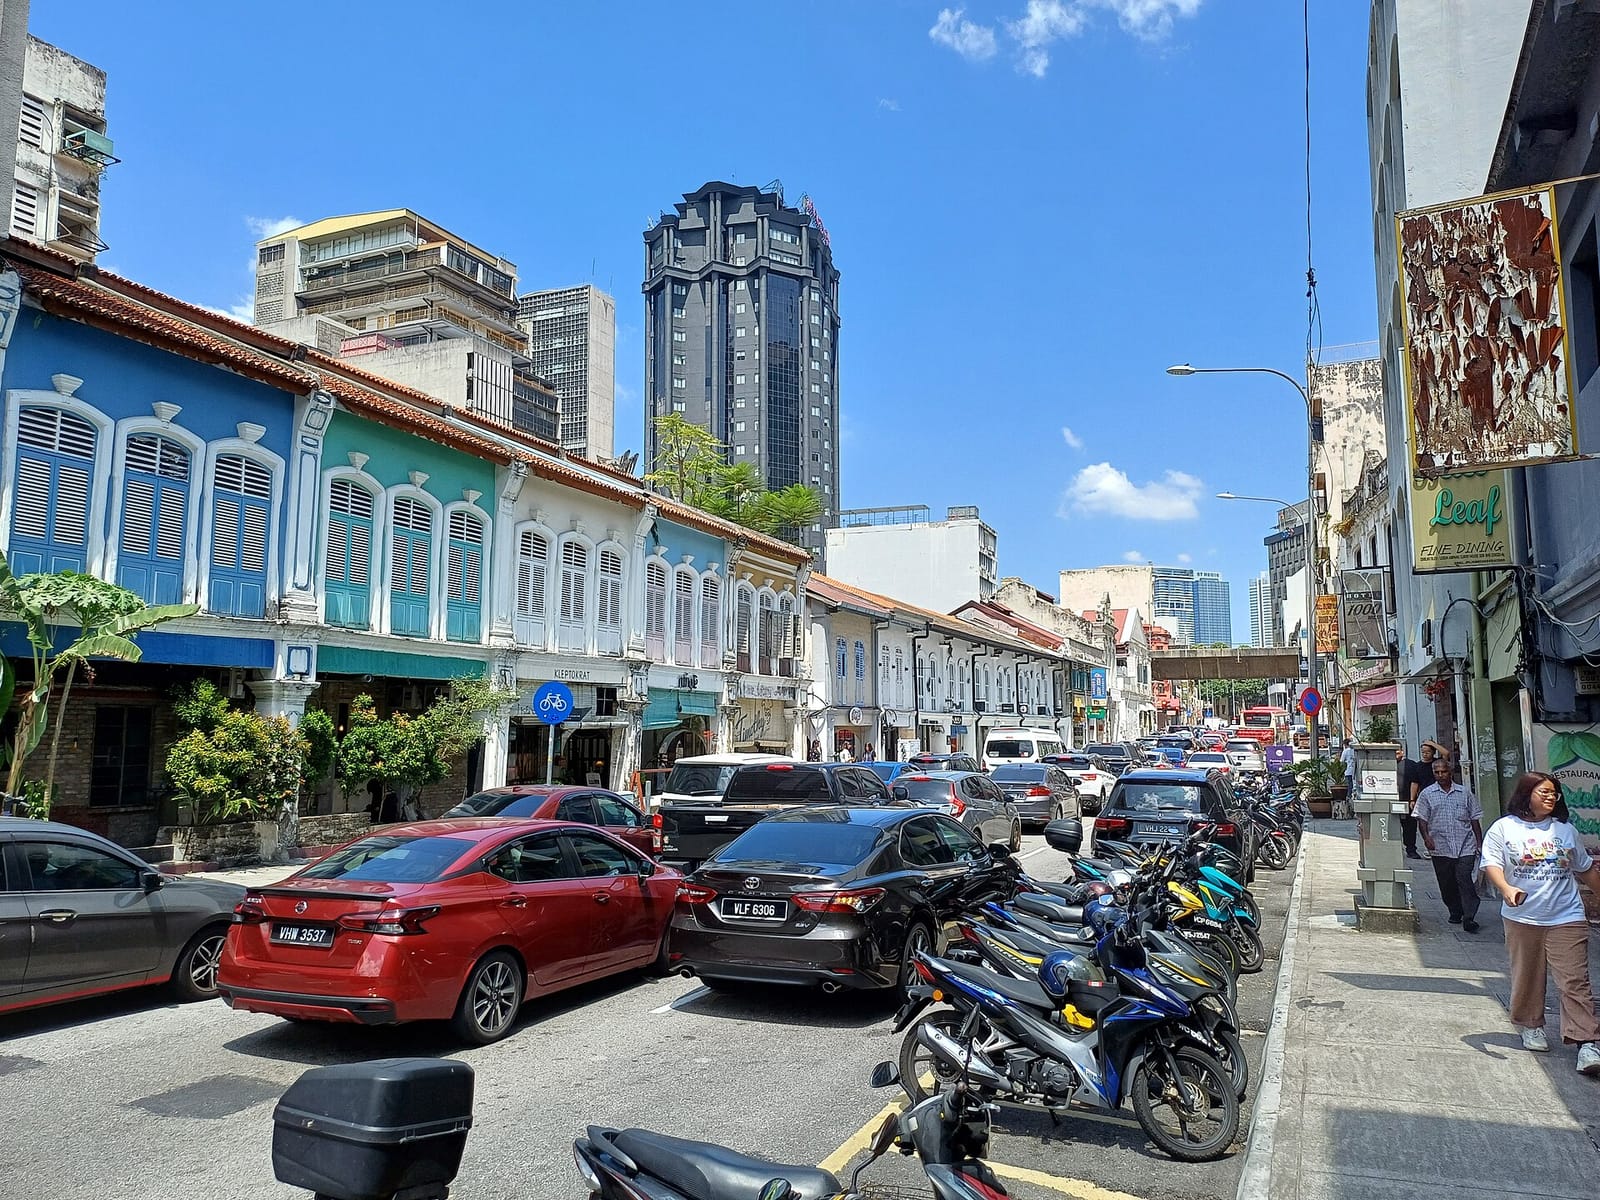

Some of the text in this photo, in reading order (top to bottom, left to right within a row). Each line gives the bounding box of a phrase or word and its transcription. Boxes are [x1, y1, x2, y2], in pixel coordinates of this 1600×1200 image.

[1429, 484, 1502, 536] Leaf
[1420, 540, 1505, 556] FINE DINING
[1347, 603, 1380, 616] 1000
[554, 669, 590, 680] KLEPTOKRAT
[734, 903, 775, 916] VLF 6306
[279, 926, 326, 942] VHW 3537
